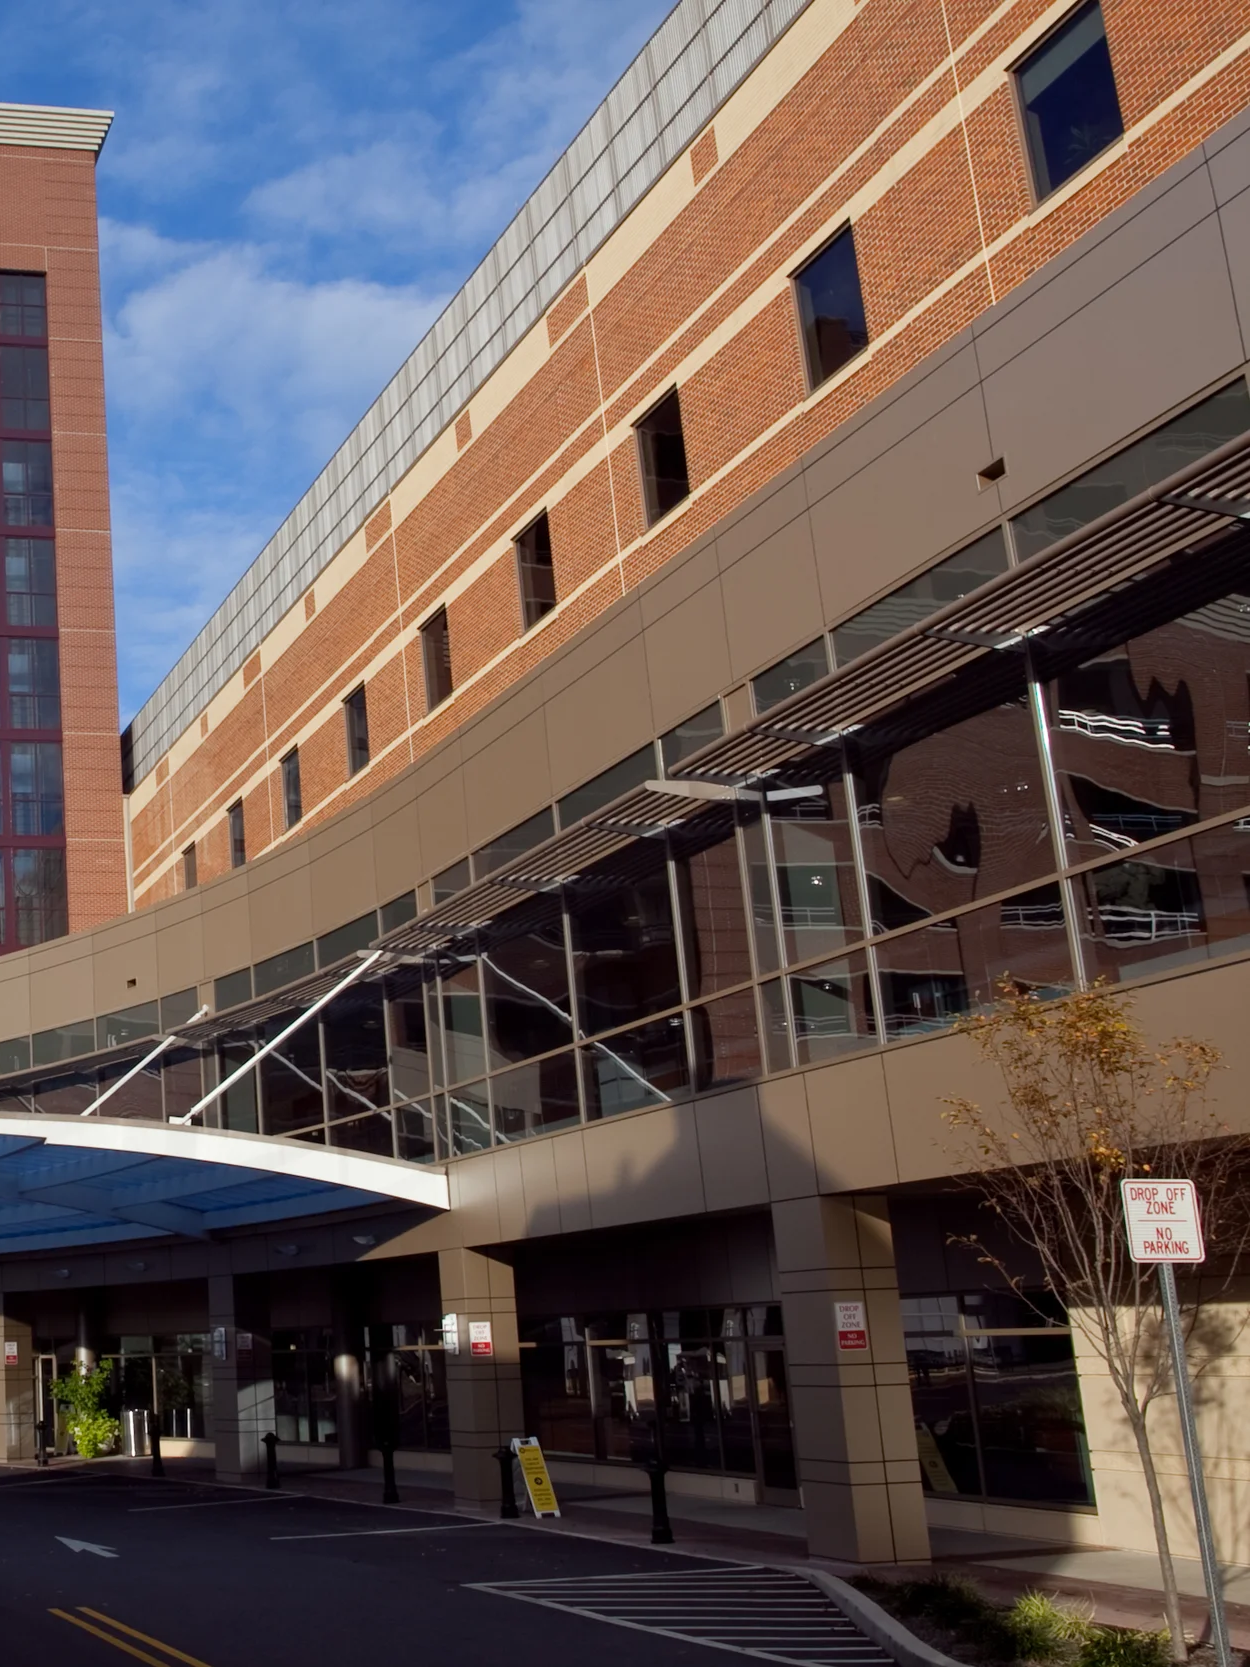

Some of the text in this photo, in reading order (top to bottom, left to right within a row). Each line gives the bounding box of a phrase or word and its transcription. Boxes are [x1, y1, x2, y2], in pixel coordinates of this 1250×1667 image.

[1130, 1187, 1186, 1201] DROP OFF
[1146, 1201, 1176, 1215] ZONE
[1156, 1227, 1173, 1241] NO
[1143, 1241, 1190, 1255] PARKING
